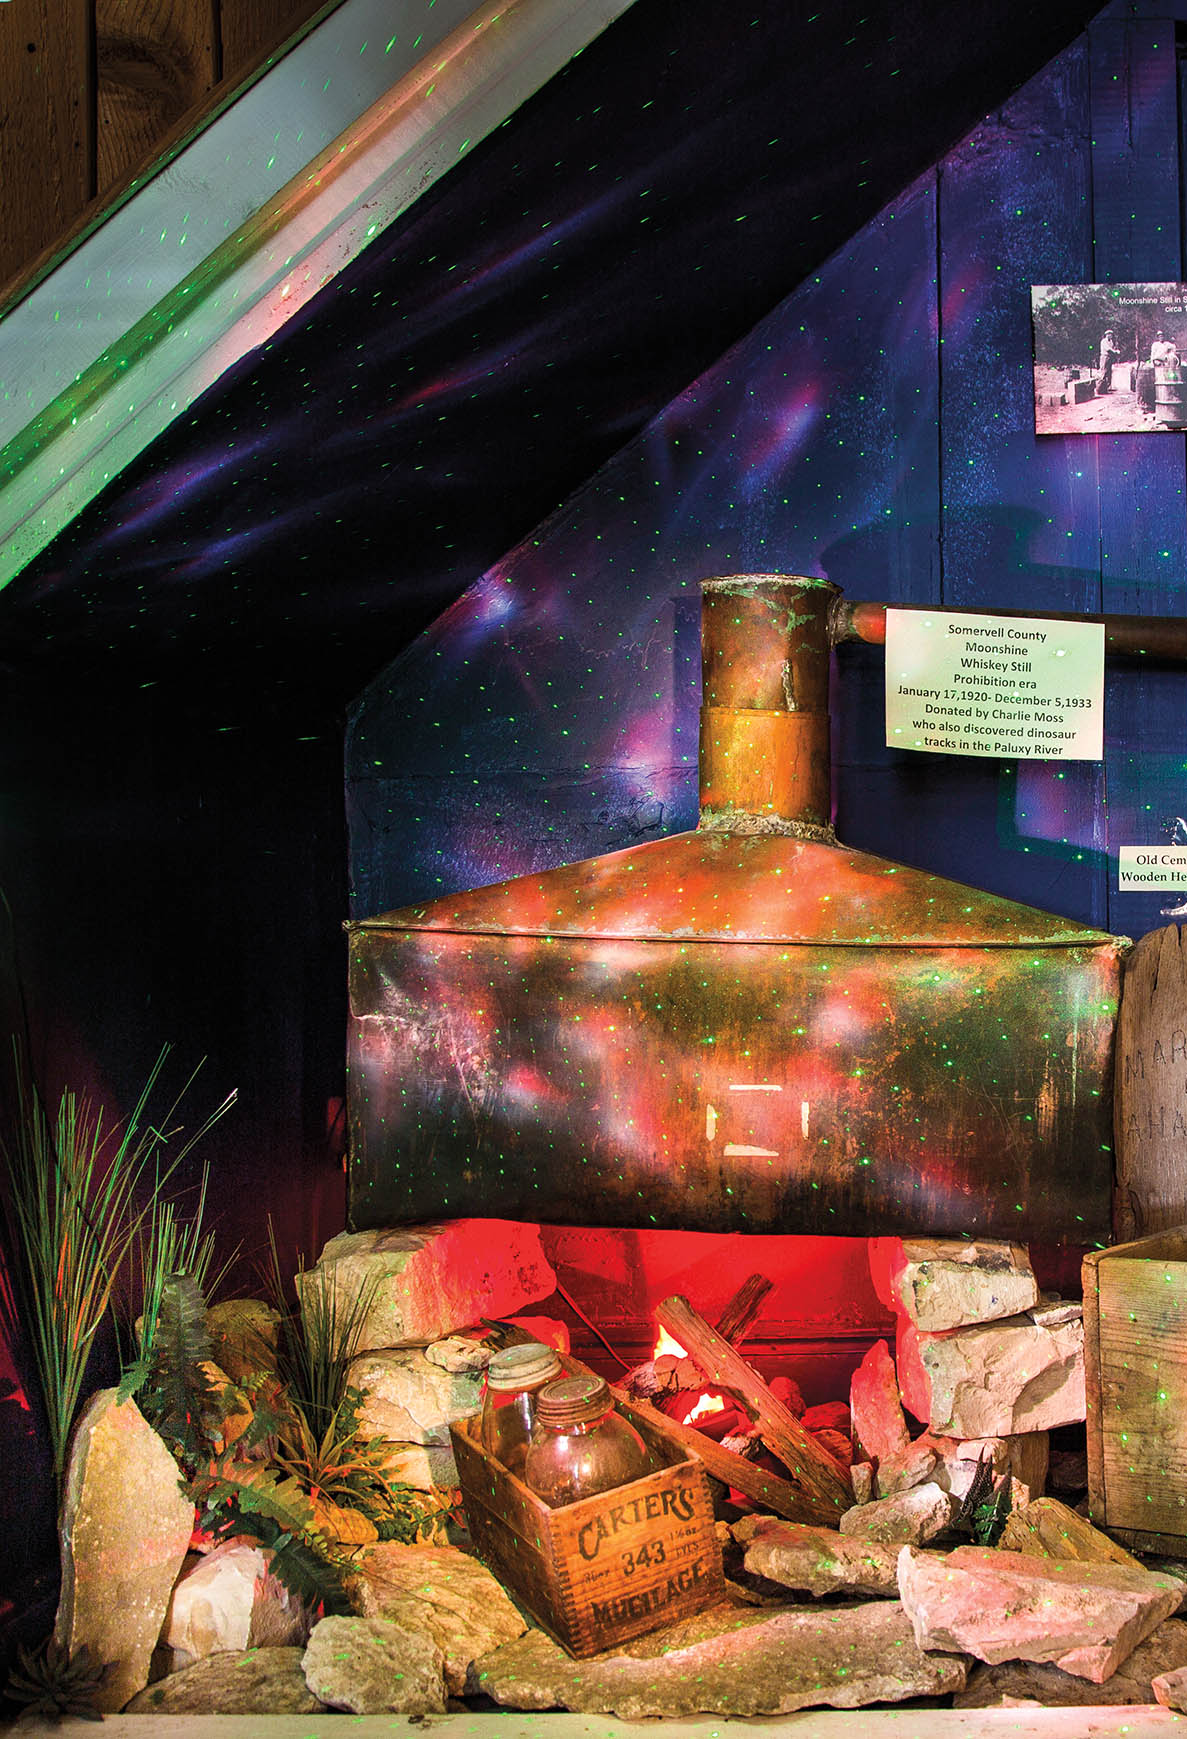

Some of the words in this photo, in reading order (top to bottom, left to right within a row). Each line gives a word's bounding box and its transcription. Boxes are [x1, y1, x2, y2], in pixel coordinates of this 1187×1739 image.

[1119, 297, 1158, 305] Moonshine
[1160, 296, 1173, 304] Still
[1174, 295, 1182, 303] in
[1165, 304, 1182, 312] circa
[948, 624, 1005, 638] Somervell
[1007, 629, 1047, 643] County
[965, 642, 1028, 656] Moonshine
[960, 658, 1008, 672] Whiskey
[1011, 661, 1032, 672] Still
[954, 674, 1016, 688] Prohibition
[1018, 680, 1037, 689] era
[898, 685, 941, 700] January
[943, 689, 992, 703] 17,1920-
[995, 693, 1052, 707] December
[1055, 697, 1092, 709] 5,1933
[925, 704, 972, 717] Donated
[975, 707, 989, 720] by
[992, 709, 1031, 722] Charlie
[1034, 712, 1064, 723] Moss
[912, 719, 936, 730] who
[939, 721, 961, 733] also
[963, 722, 1024, 738] discovered
[1027, 727, 1077, 740] dinosaur
[924, 736, 956, 749] tracks
[959, 739, 970, 750] in
[972, 739, 991, 751] the
[994, 742, 1031, 756] Paluxy
[1034, 743, 1063, 756] River
[1136, 854, 1158, 865] Old
[1120, 871, 1167, 882] Wooden
[621, 1540, 666, 1576] 343
